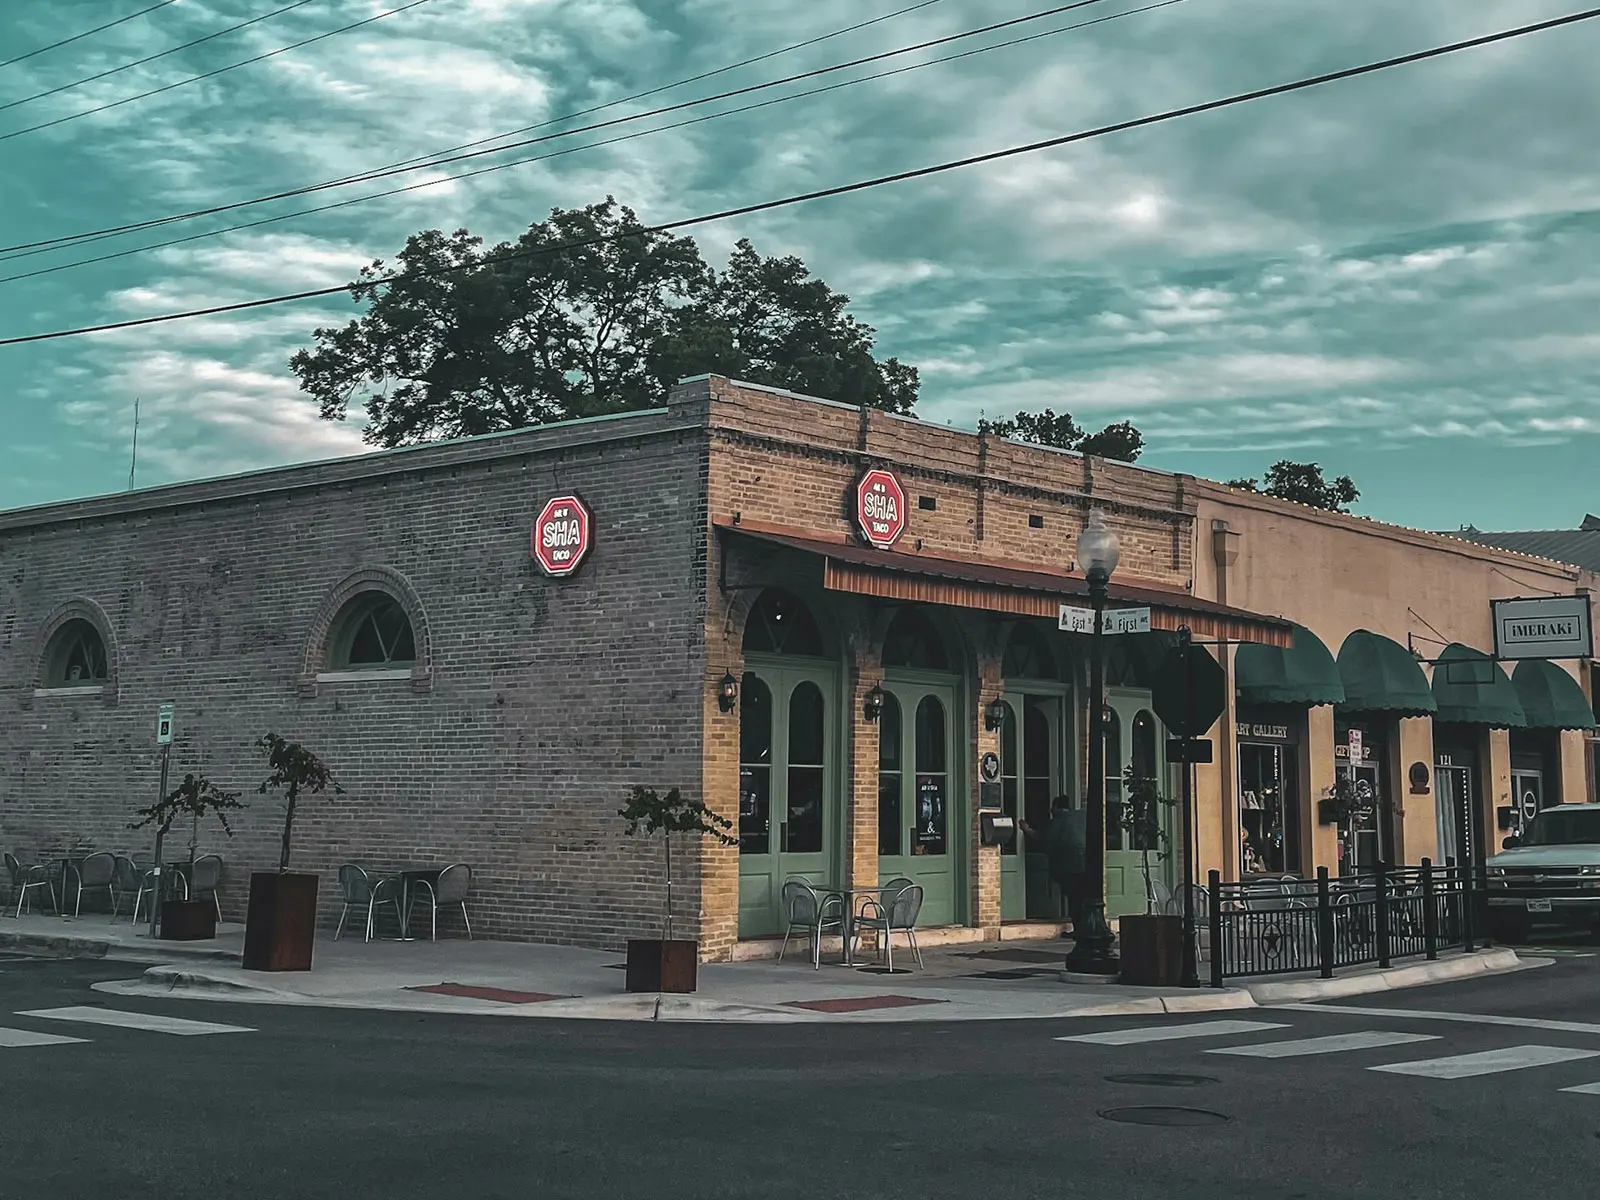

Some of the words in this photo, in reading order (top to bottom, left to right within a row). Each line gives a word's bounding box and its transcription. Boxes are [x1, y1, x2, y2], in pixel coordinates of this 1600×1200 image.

[864, 492, 898, 522] SHA
[542, 519, 580, 547] SHA
[872, 521, 889, 534] TACO
[553, 549, 570, 560] TACO
[1072, 616, 1086, 630] East
[1118, 617, 1138, 631] First
[1253, 724, 1288, 738] GALLERY
[1440, 754, 1452, 766] 121
